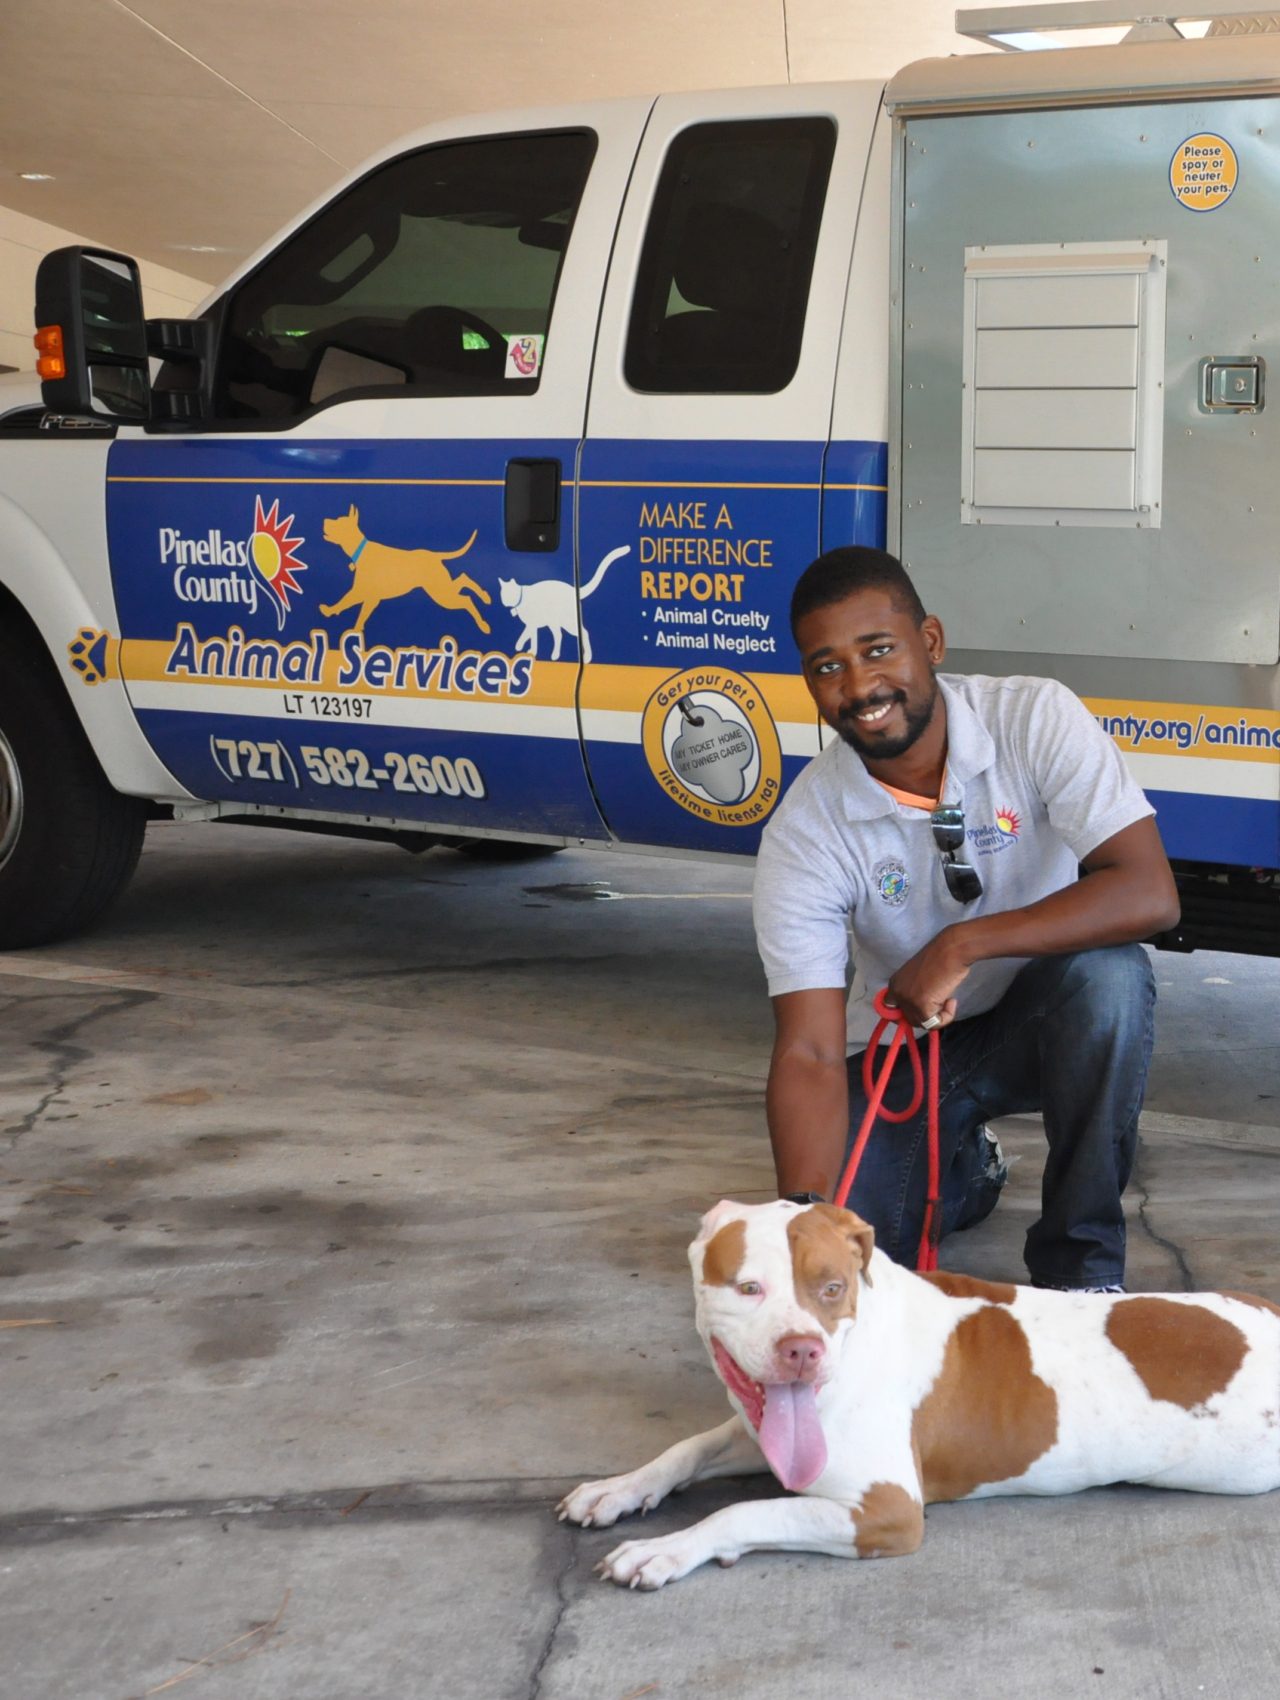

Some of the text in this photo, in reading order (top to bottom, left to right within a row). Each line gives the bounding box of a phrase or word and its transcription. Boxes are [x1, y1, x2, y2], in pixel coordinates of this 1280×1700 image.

[1182, 159, 1223, 172] spay or
[1184, 146, 1221, 157] Please
[1177, 184, 1231, 197] your pets.
[1184, 172, 1221, 182] neuter
[639, 502, 733, 530] MAKE A
[159, 528, 247, 567] Pinellas
[640, 537, 773, 567] DIFFERENCE
[174, 565, 257, 614] County
[641, 571, 744, 602] REPORT
[654, 606, 770, 631] Animal Cruelty
[655, 631, 776, 654] Animal Neglect
[165, 626, 534, 698] Animal Services
[284, 694, 372, 718] LT 123197
[657, 674, 756, 712] Get your pet a
[688, 738, 715, 755] TICKET
[718, 729, 742, 744] HOME
[691, 752, 720, 769] OWNER
[720, 741, 747, 759] CARES
[210, 734, 486, 799] (727) 582-2600
[658, 769, 778, 823] lifetime license tag
